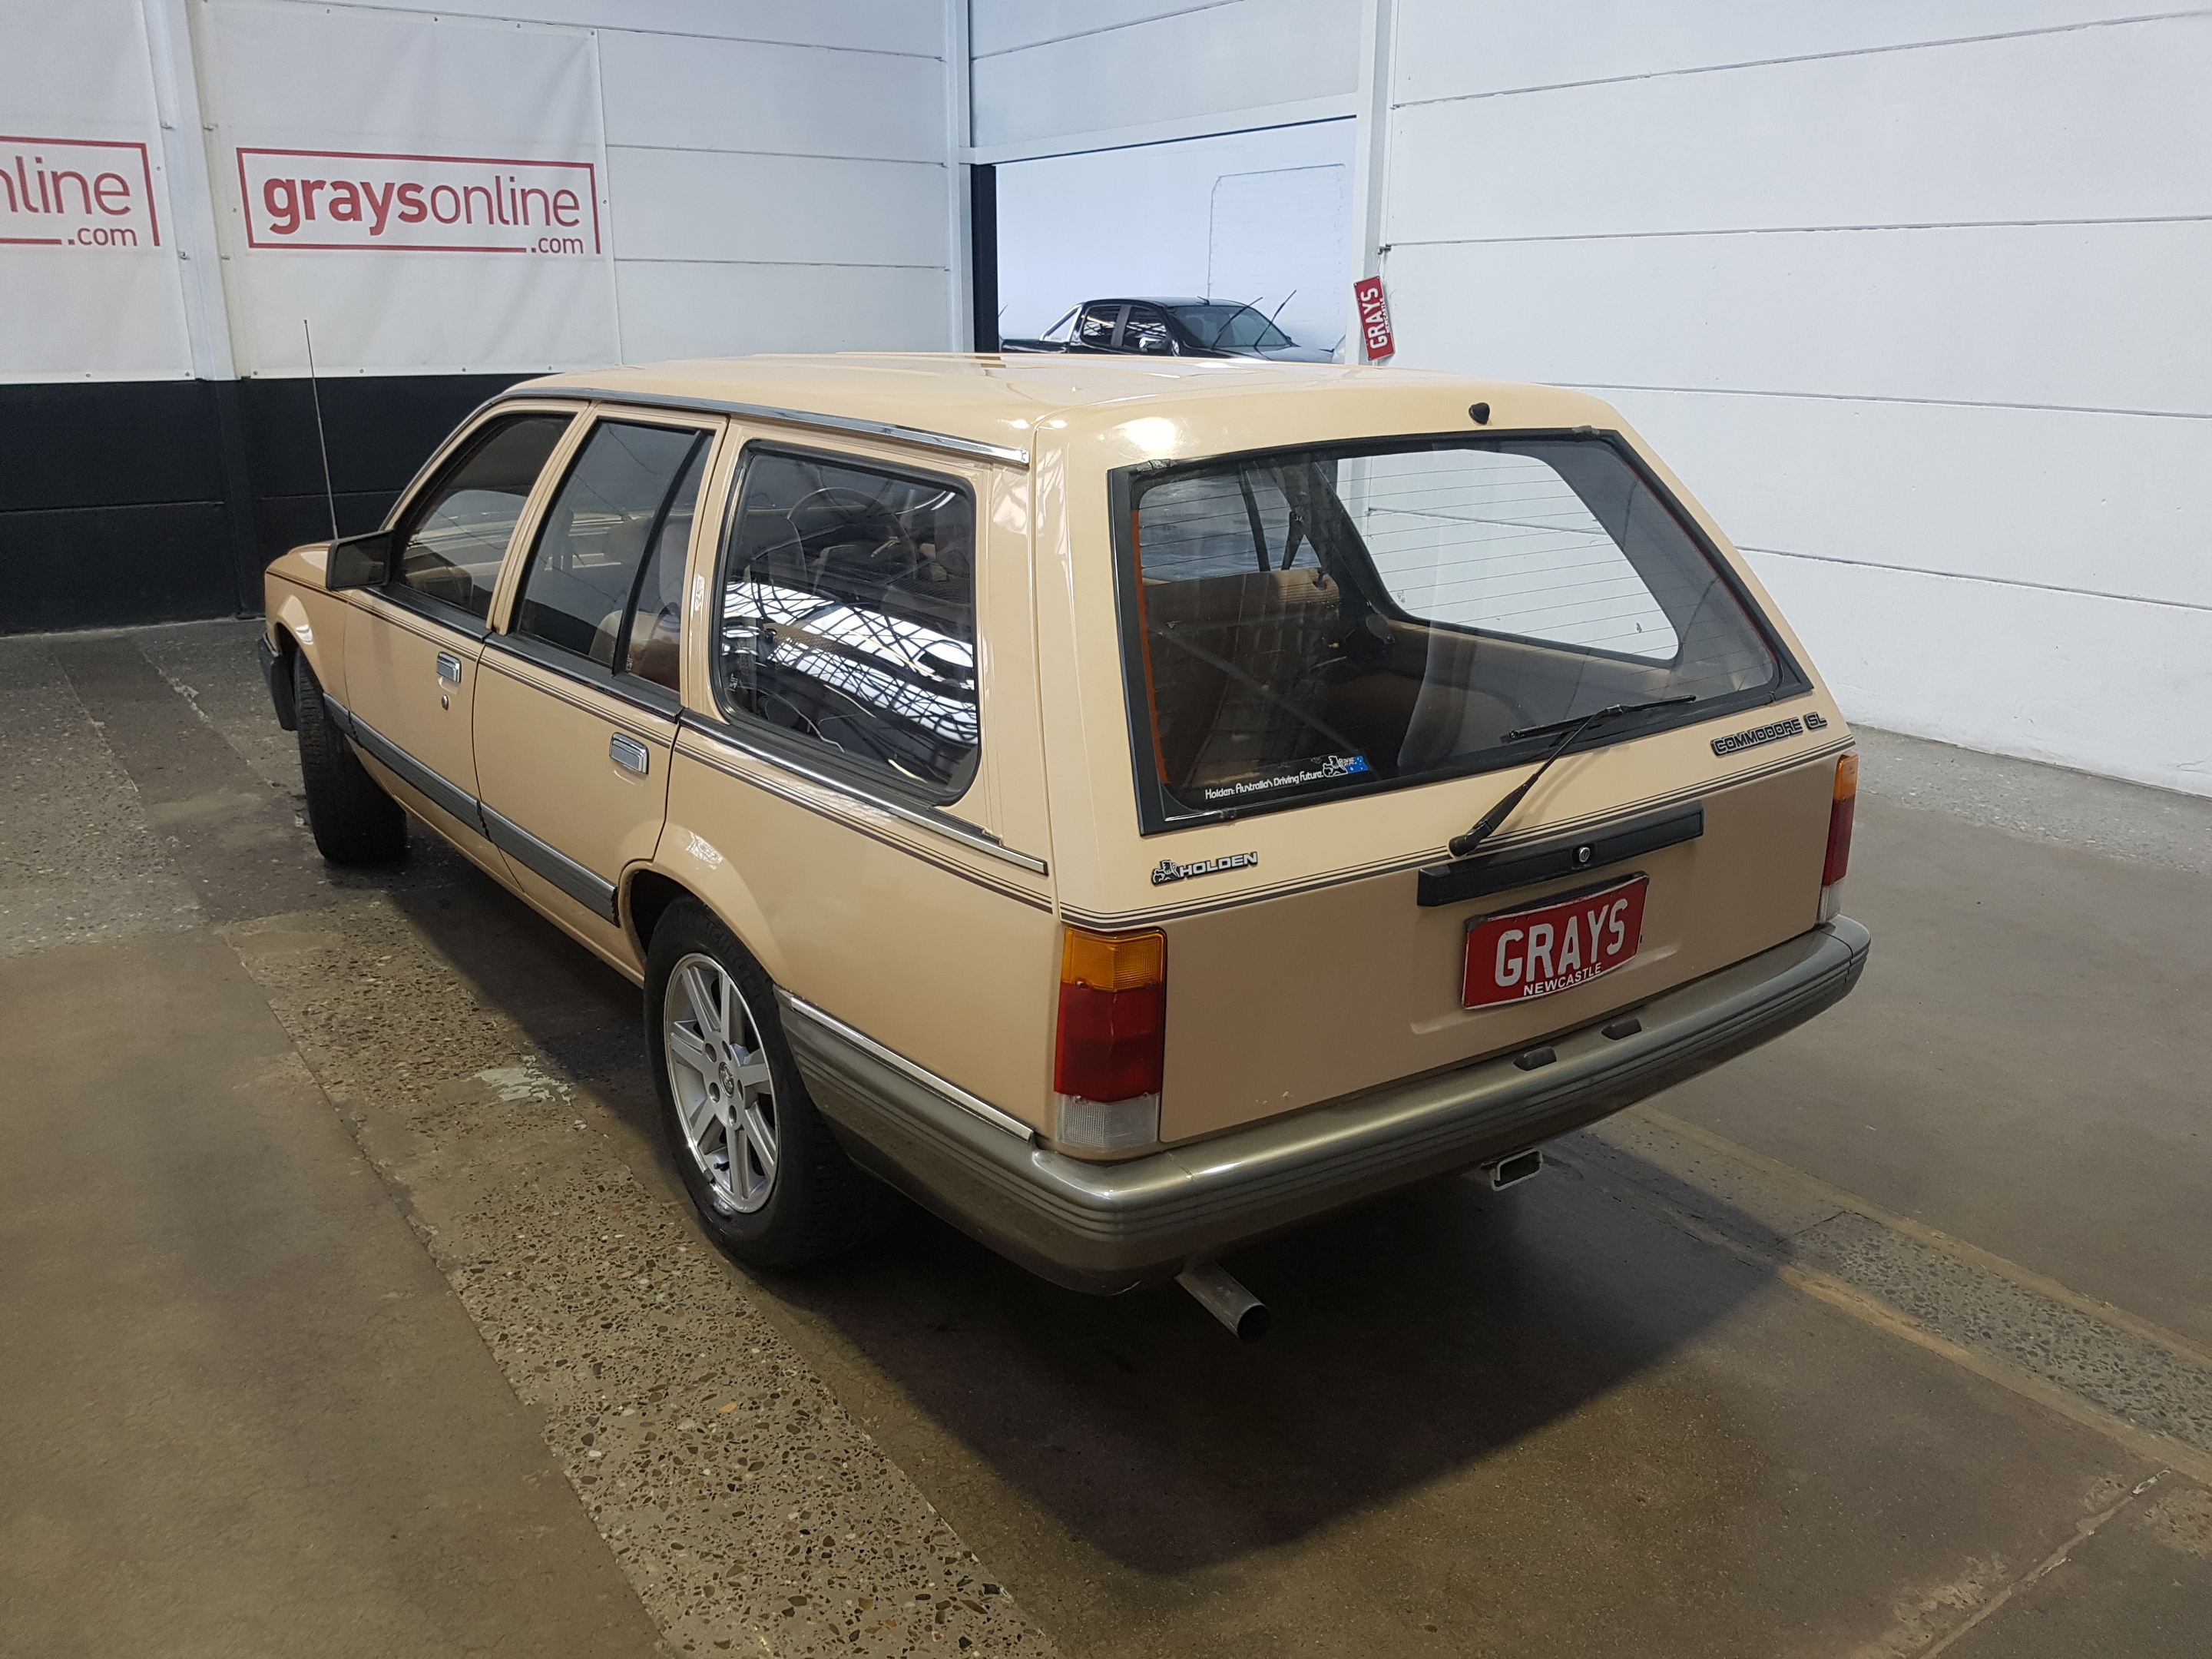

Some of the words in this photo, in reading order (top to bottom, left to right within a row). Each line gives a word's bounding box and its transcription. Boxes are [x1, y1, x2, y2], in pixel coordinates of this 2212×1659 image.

[263, 175, 581, 236] graysonline
[68, 227, 137, 247] .com
[531, 237, 584, 254] .com
[1360, 287, 1388, 349] GRAYS
[1713, 719, 1803, 755] COMMODORE
[1805, 713, 1827, 730] SL
[1273, 776, 1299, 787] Driving
[1179, 852, 1258, 878] HOLDEN
[1495, 899, 1628, 988] GRAYS
[1522, 962, 1602, 996] NEWCASTLE
